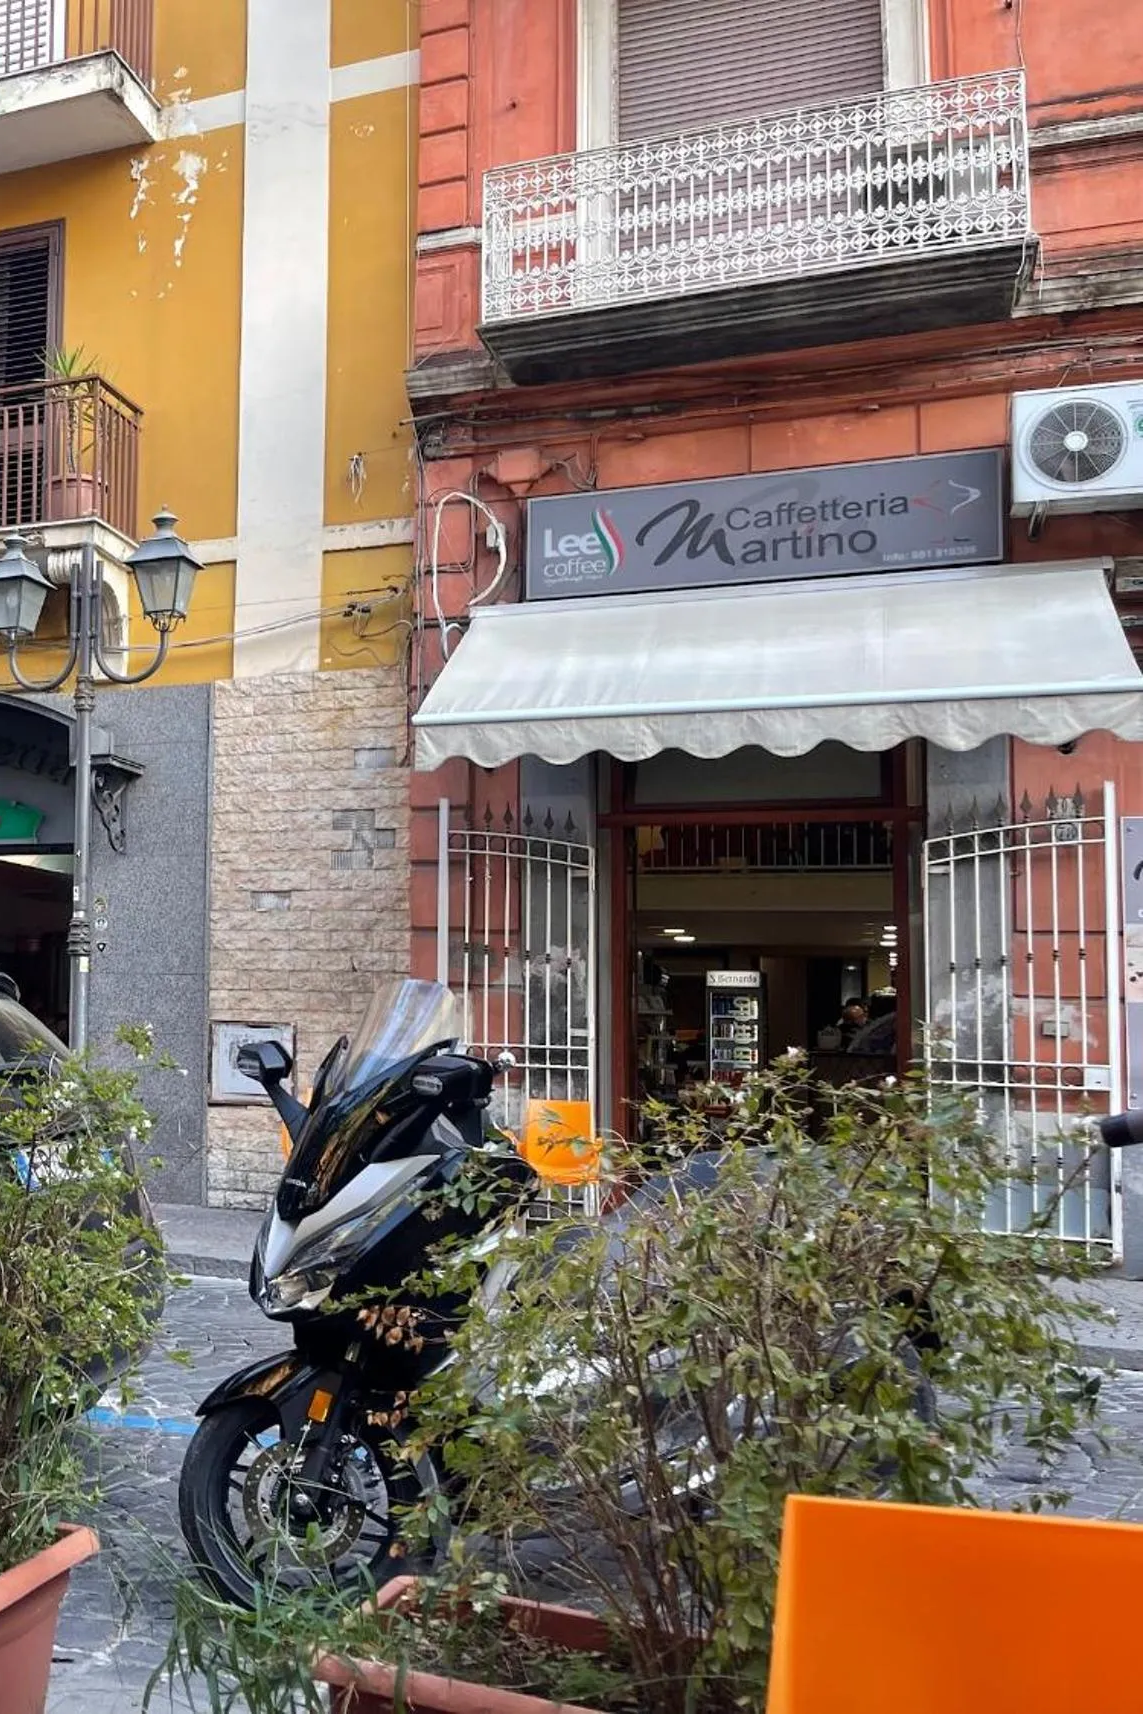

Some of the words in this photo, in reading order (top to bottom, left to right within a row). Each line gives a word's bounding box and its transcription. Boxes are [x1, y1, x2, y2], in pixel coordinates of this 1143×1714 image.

[725, 492, 910, 531] Caffetteria
[543, 528, 602, 558] Lee
[543, 557, 607, 578] coffee
